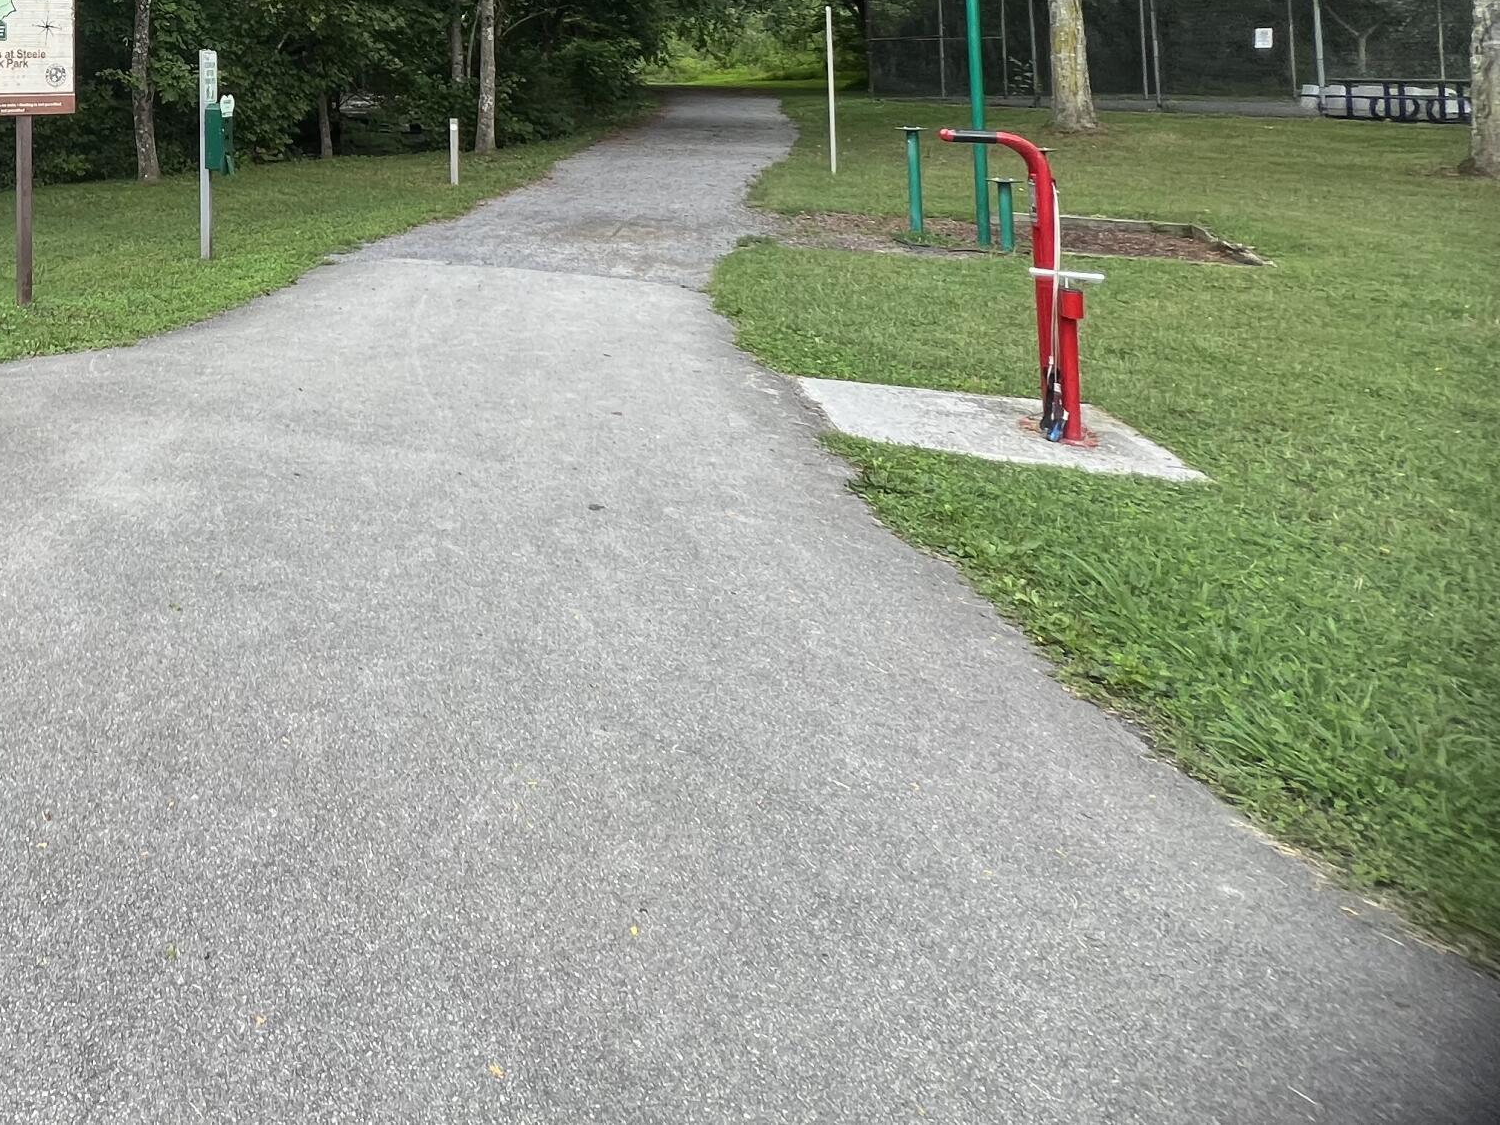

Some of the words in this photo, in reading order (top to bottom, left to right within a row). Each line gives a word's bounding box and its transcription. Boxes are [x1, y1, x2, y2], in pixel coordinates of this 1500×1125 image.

[5, 50, 15, 59] at
[17, 49, 46, 59] Steele
[7, 59, 29, 68] Park
